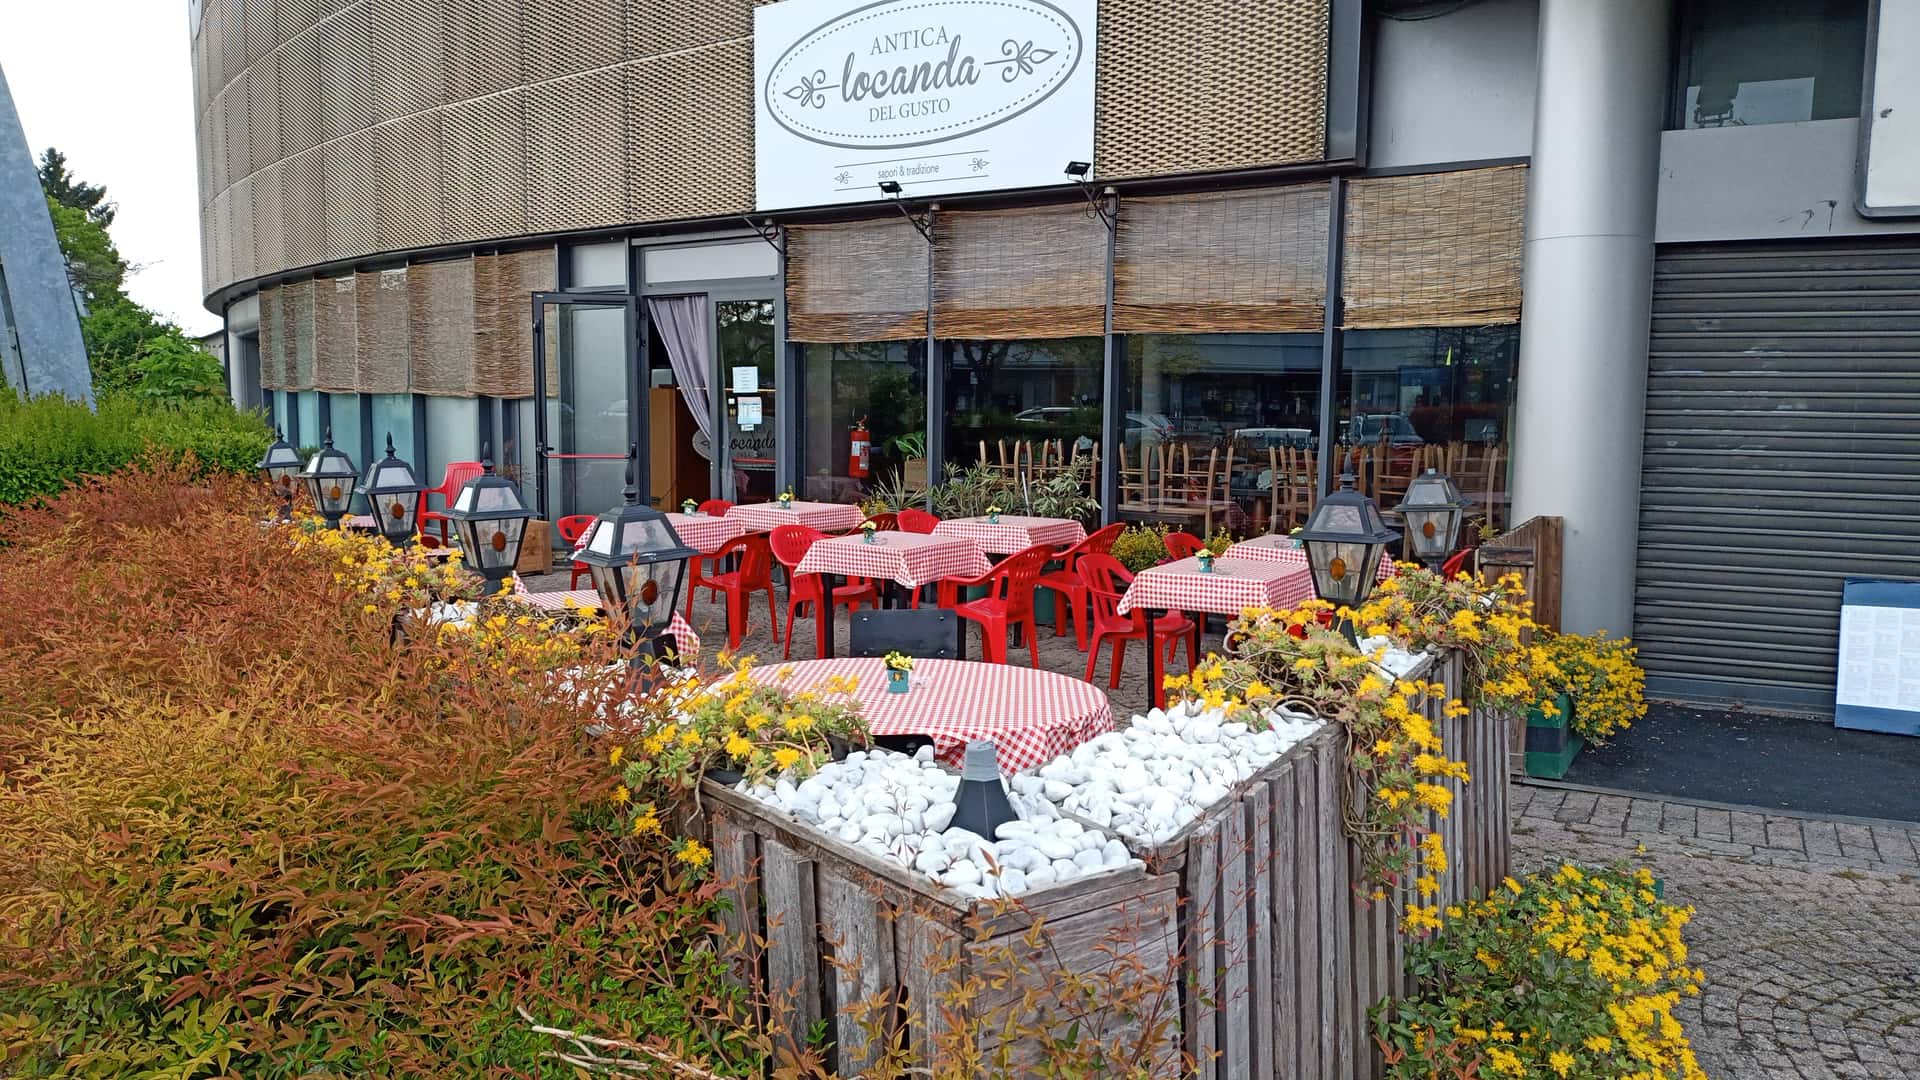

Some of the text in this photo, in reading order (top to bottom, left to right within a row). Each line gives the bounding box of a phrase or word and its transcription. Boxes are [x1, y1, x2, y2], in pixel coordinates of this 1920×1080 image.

[870, 25, 949, 55] ANTICA
[841, 34, 981, 102] locanda
[869, 97, 951, 122] DEL GUSTO
[877, 163, 940, 179] sapori & tradizione
[730, 431, 776, 450] ocanda
